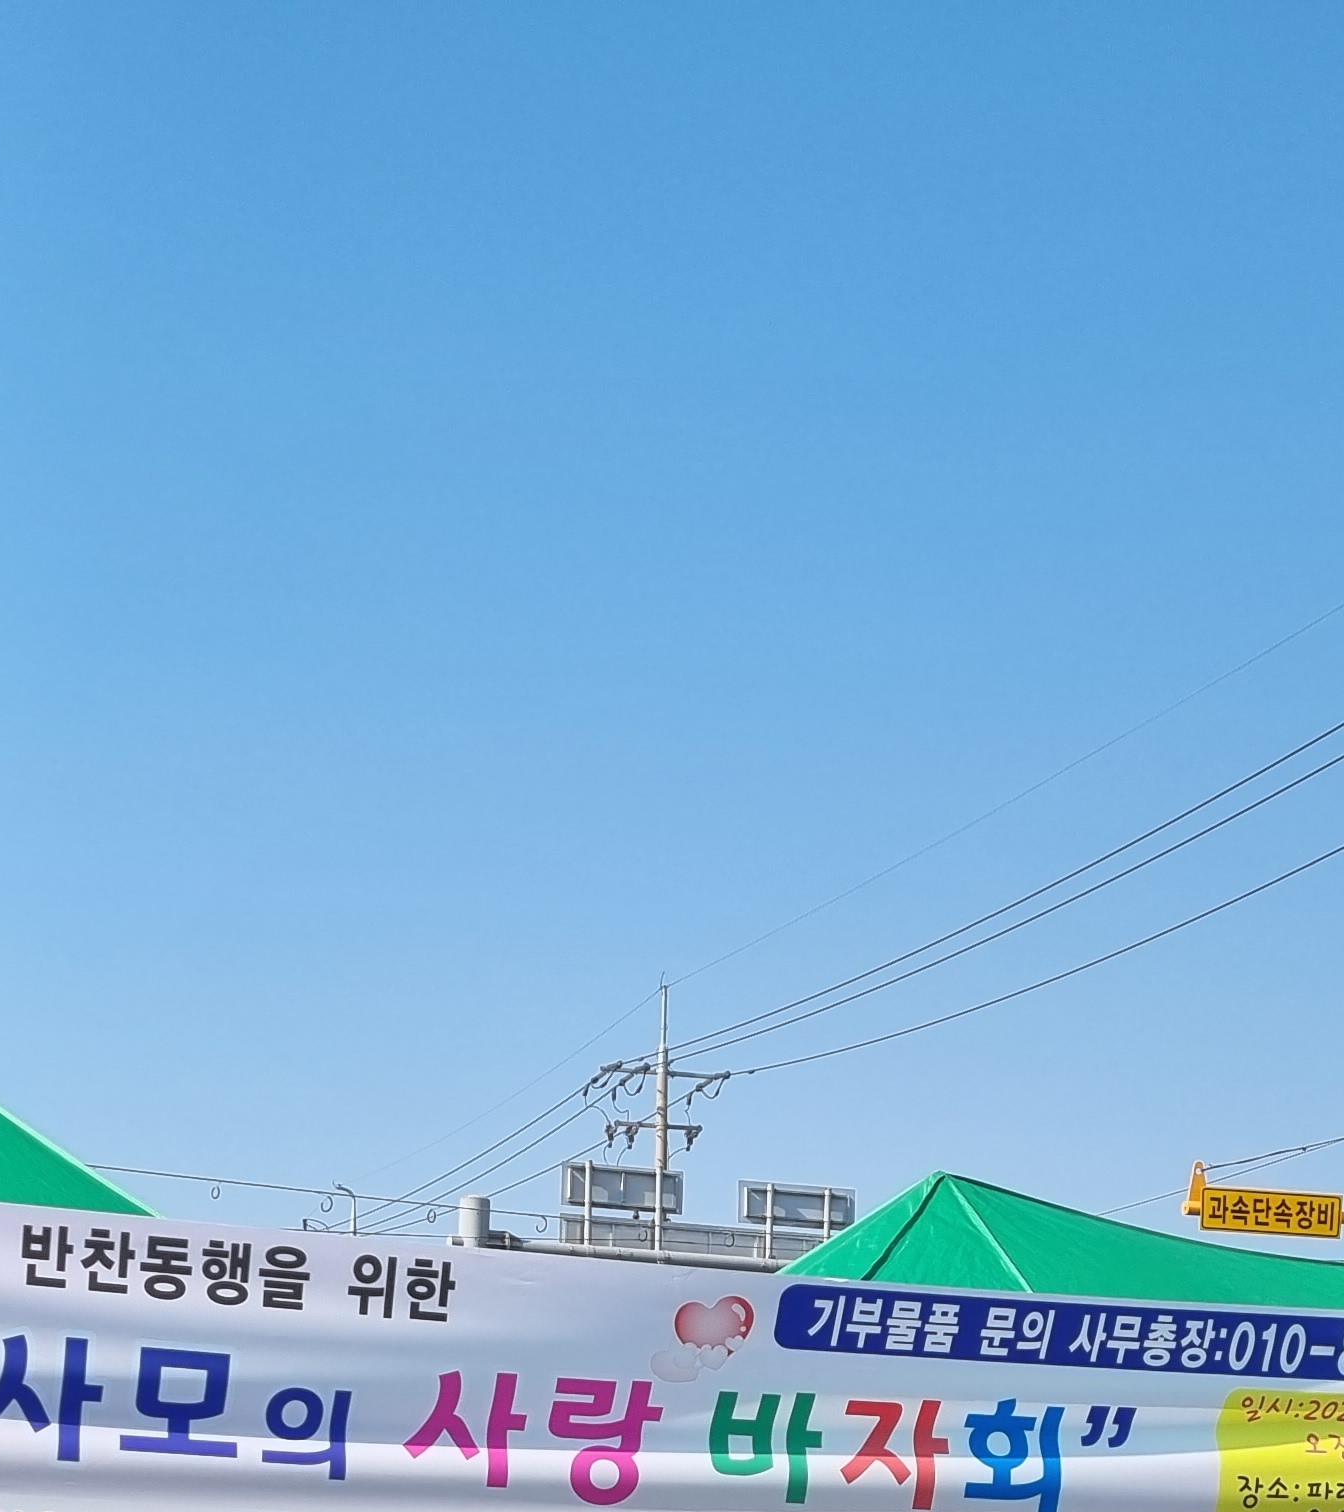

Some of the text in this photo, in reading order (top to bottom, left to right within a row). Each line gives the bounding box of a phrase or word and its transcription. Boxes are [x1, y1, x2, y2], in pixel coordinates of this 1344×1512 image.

[1208, 1194, 1336, 1231] 과속단속장비
[20, 1222, 312, 1311] 반찬동행을
[347, 1253, 457, 1323] 위한
[807, 1294, 961, 1353] 기부물품
[979, 1307, 1056, 1359] 문의
[402, 1369, 665, 1506] 사랑
